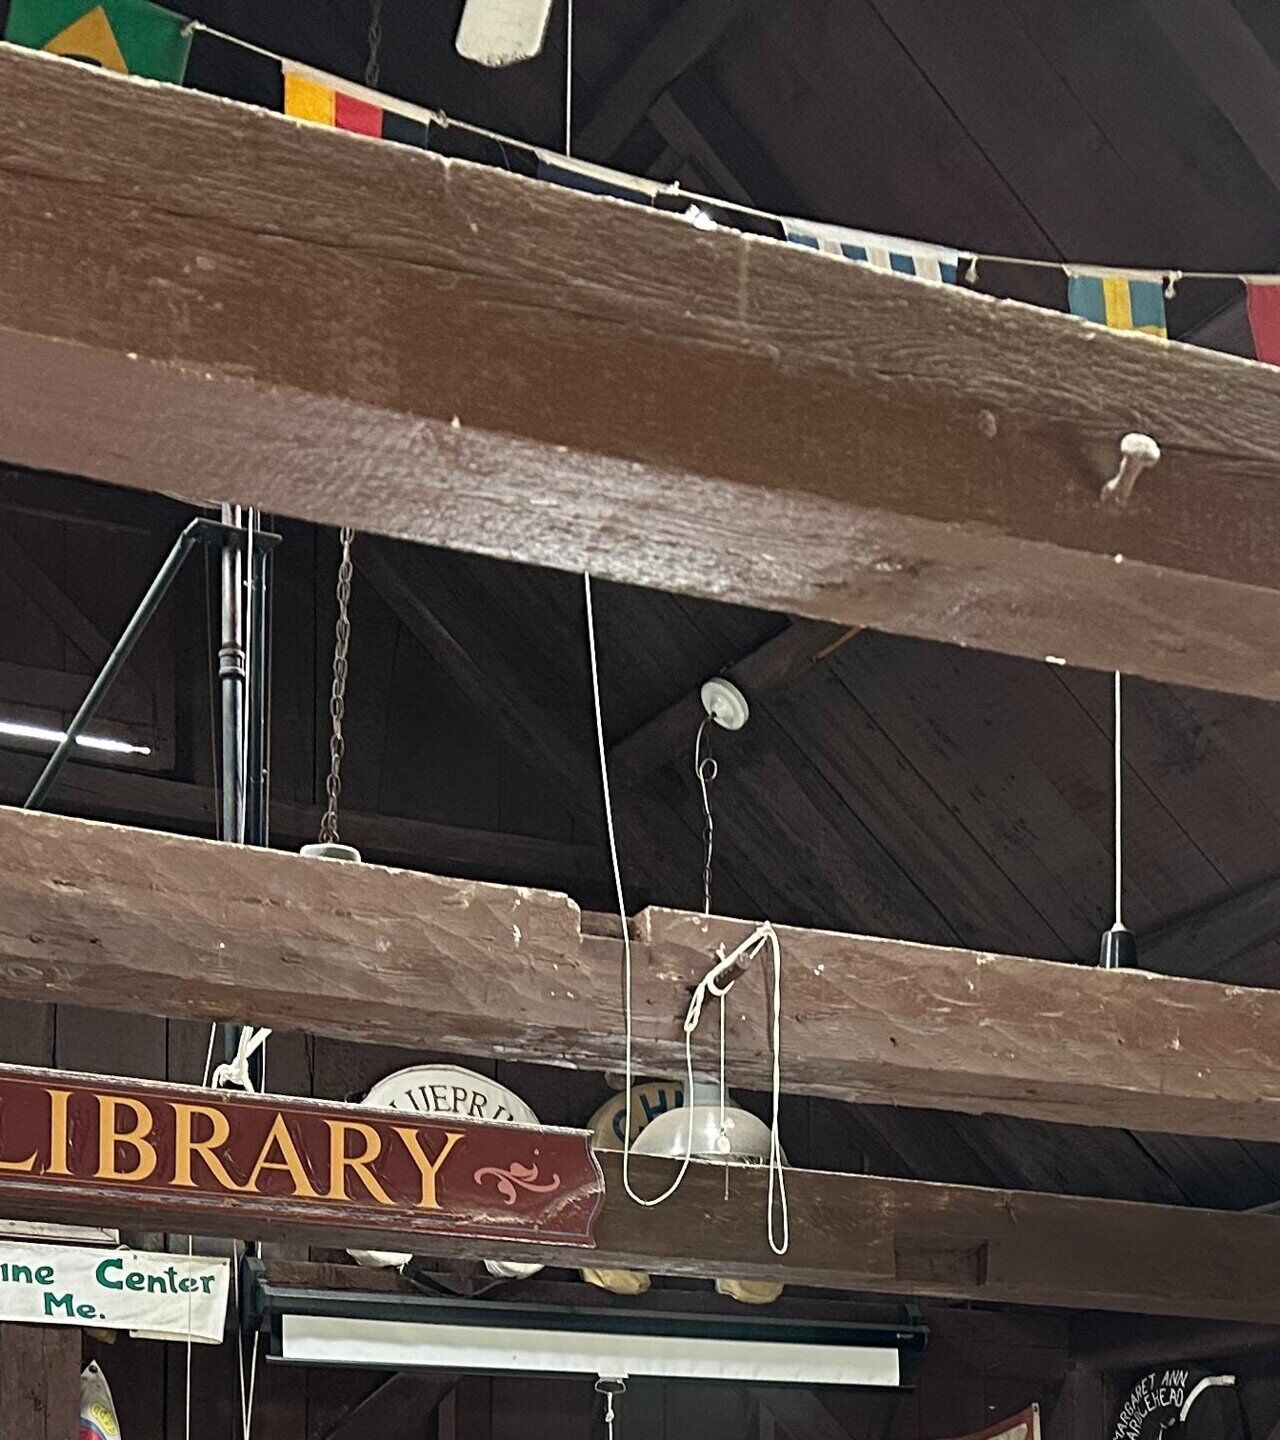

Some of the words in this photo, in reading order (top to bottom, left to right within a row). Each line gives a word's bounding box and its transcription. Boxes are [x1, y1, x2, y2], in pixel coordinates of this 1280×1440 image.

[95, 1259, 216, 1296] Center
[43, 1291, 106, 1321] Me.
[1161, 1369, 1189, 1388] ANN
